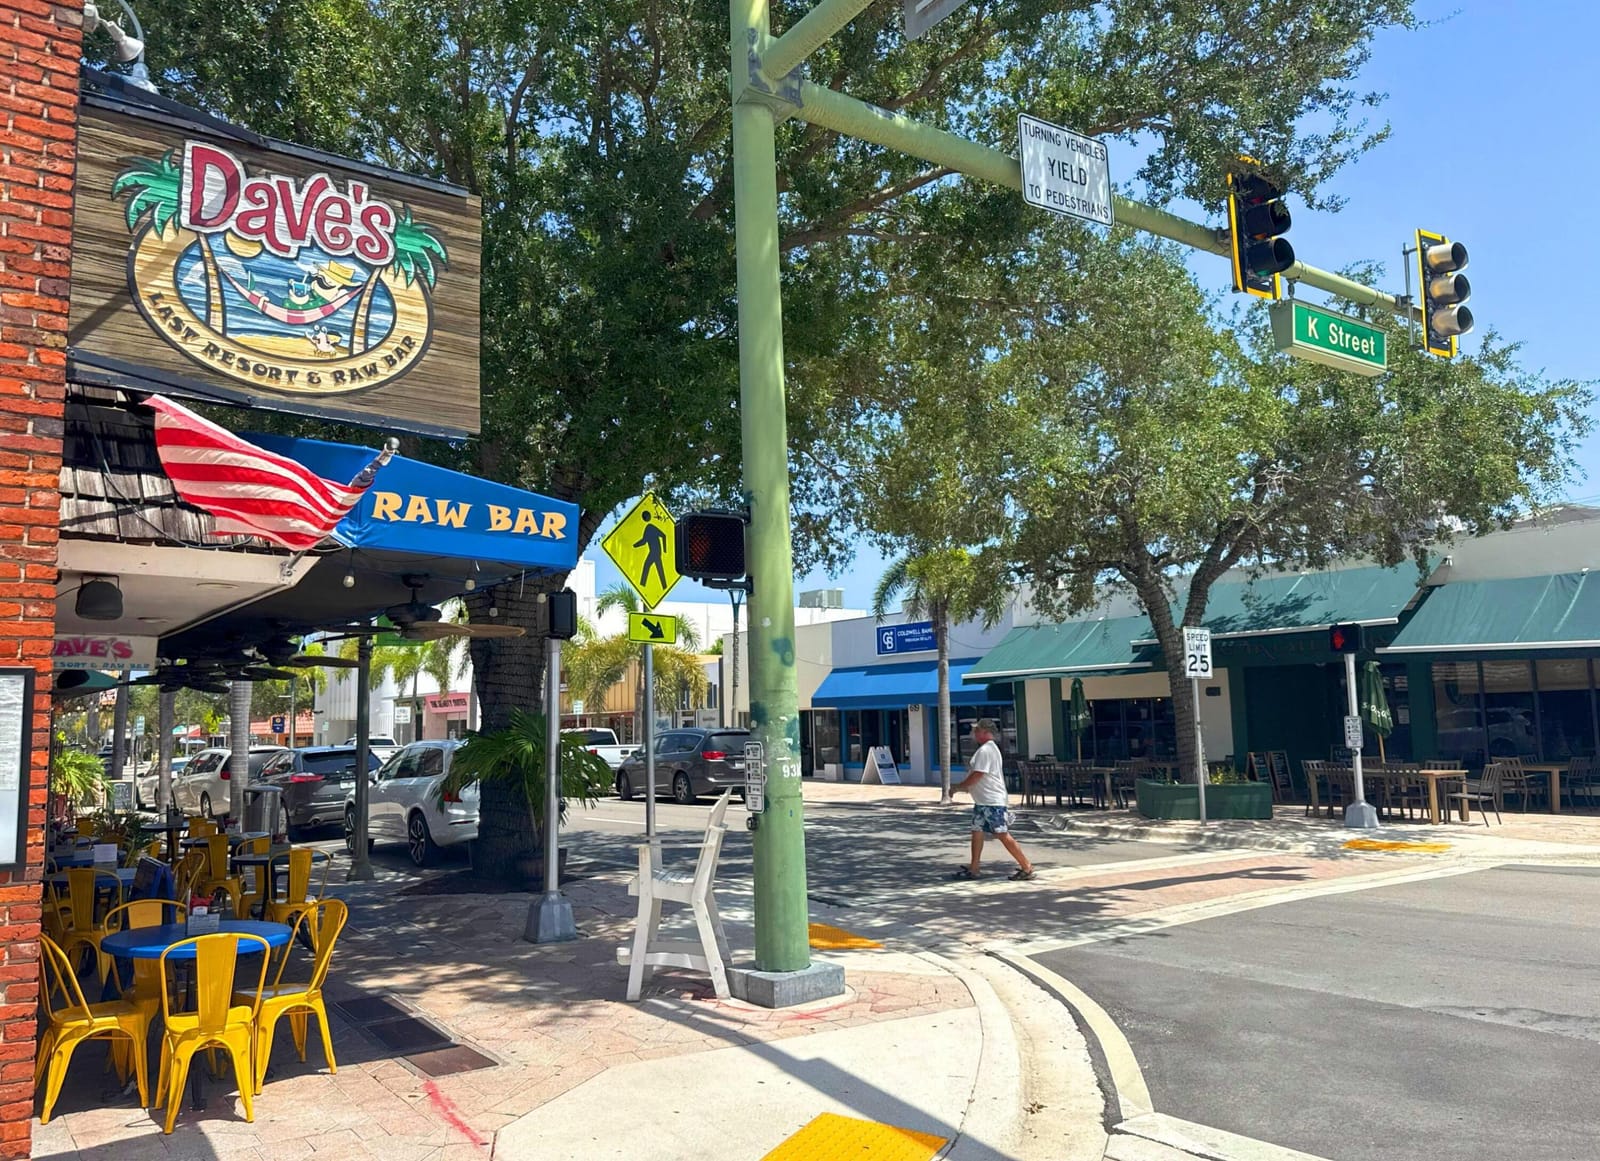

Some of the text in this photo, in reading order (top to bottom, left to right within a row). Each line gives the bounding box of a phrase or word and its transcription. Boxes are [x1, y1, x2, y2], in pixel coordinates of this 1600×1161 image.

[1023, 122, 1106, 162] TURNING VEHICLES
[1047, 157, 1087, 186] YIELD
[189, 145, 391, 261] Dave's
[1029, 183, 1109, 220] TO PEDESTRIANS
[148, 291, 418, 386] LAST RESORT & RAW BAR
[1308, 315, 1376, 356] K Street
[371, 490, 567, 540] RAW BAR
[53, 637, 134, 659] AVE'S
[1186, 633, 1209, 642] SPEED
[1189, 643, 1207, 652] LIMIT
[54, 661, 87, 669] ESORT
[103, 661, 125, 669] RAW
[1188, 654, 1210, 672] 25
